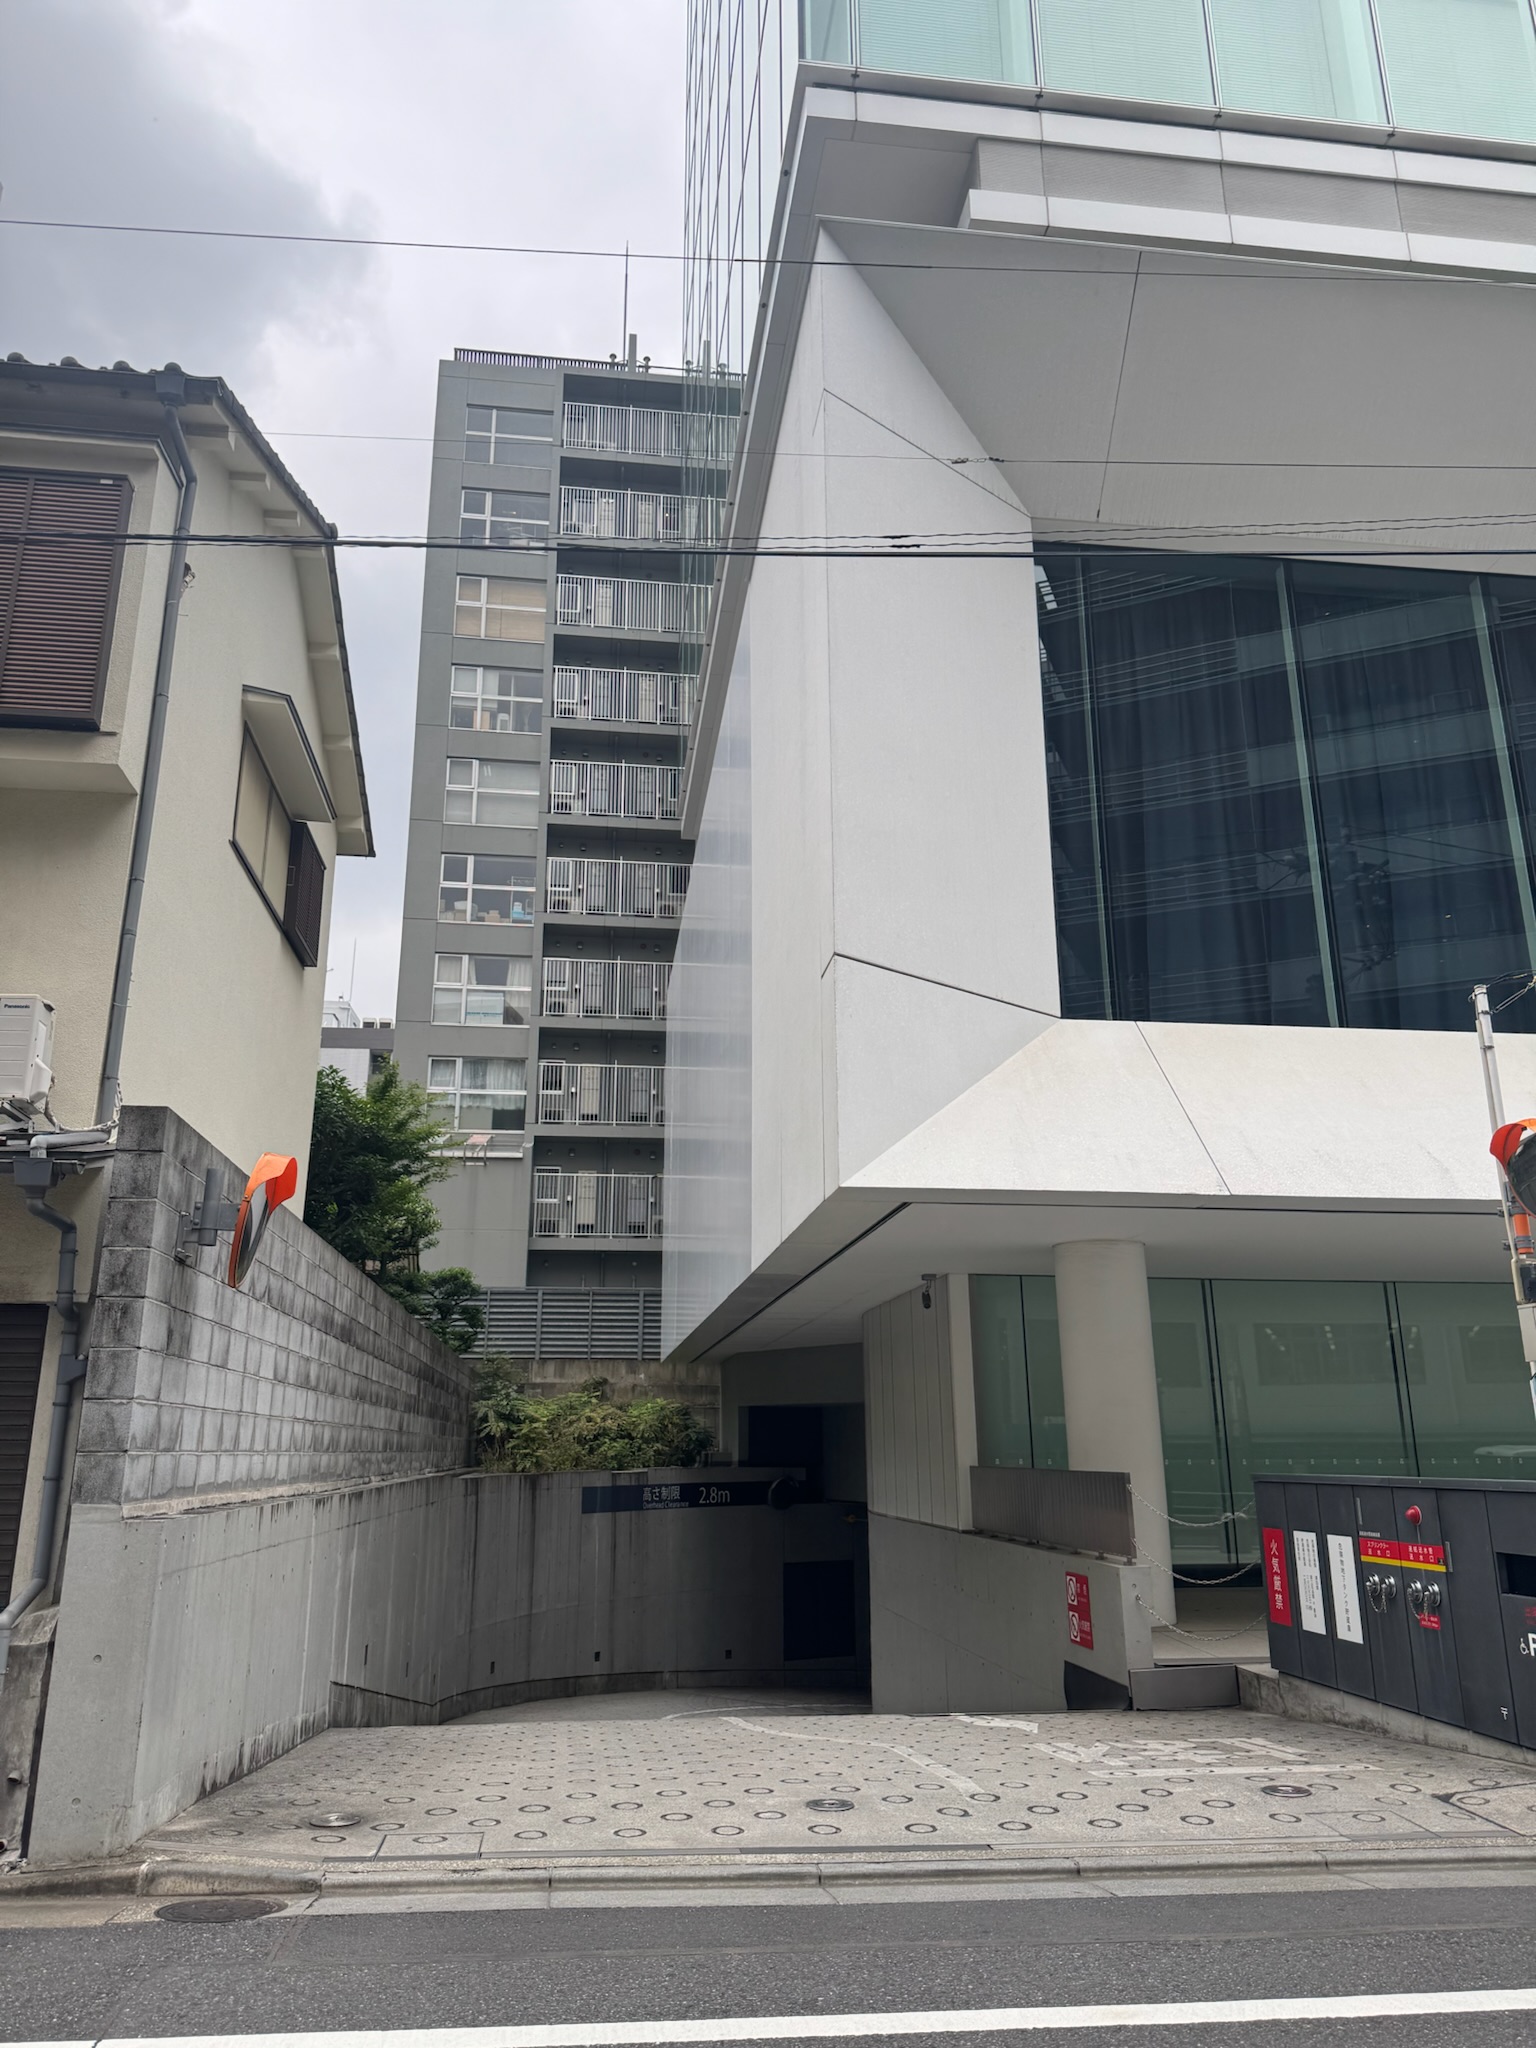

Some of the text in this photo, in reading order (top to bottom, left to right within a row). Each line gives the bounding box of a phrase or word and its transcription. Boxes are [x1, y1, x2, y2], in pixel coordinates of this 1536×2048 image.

[642, 1485, 731, 1504] 高さ制限 2.8m
[642, 1501, 689, 1509] Overhead Clearance
[1366, 1541, 1390, 1549] スプリンクラー
[1269, 1538, 1284, 1610] 火気厳禁
